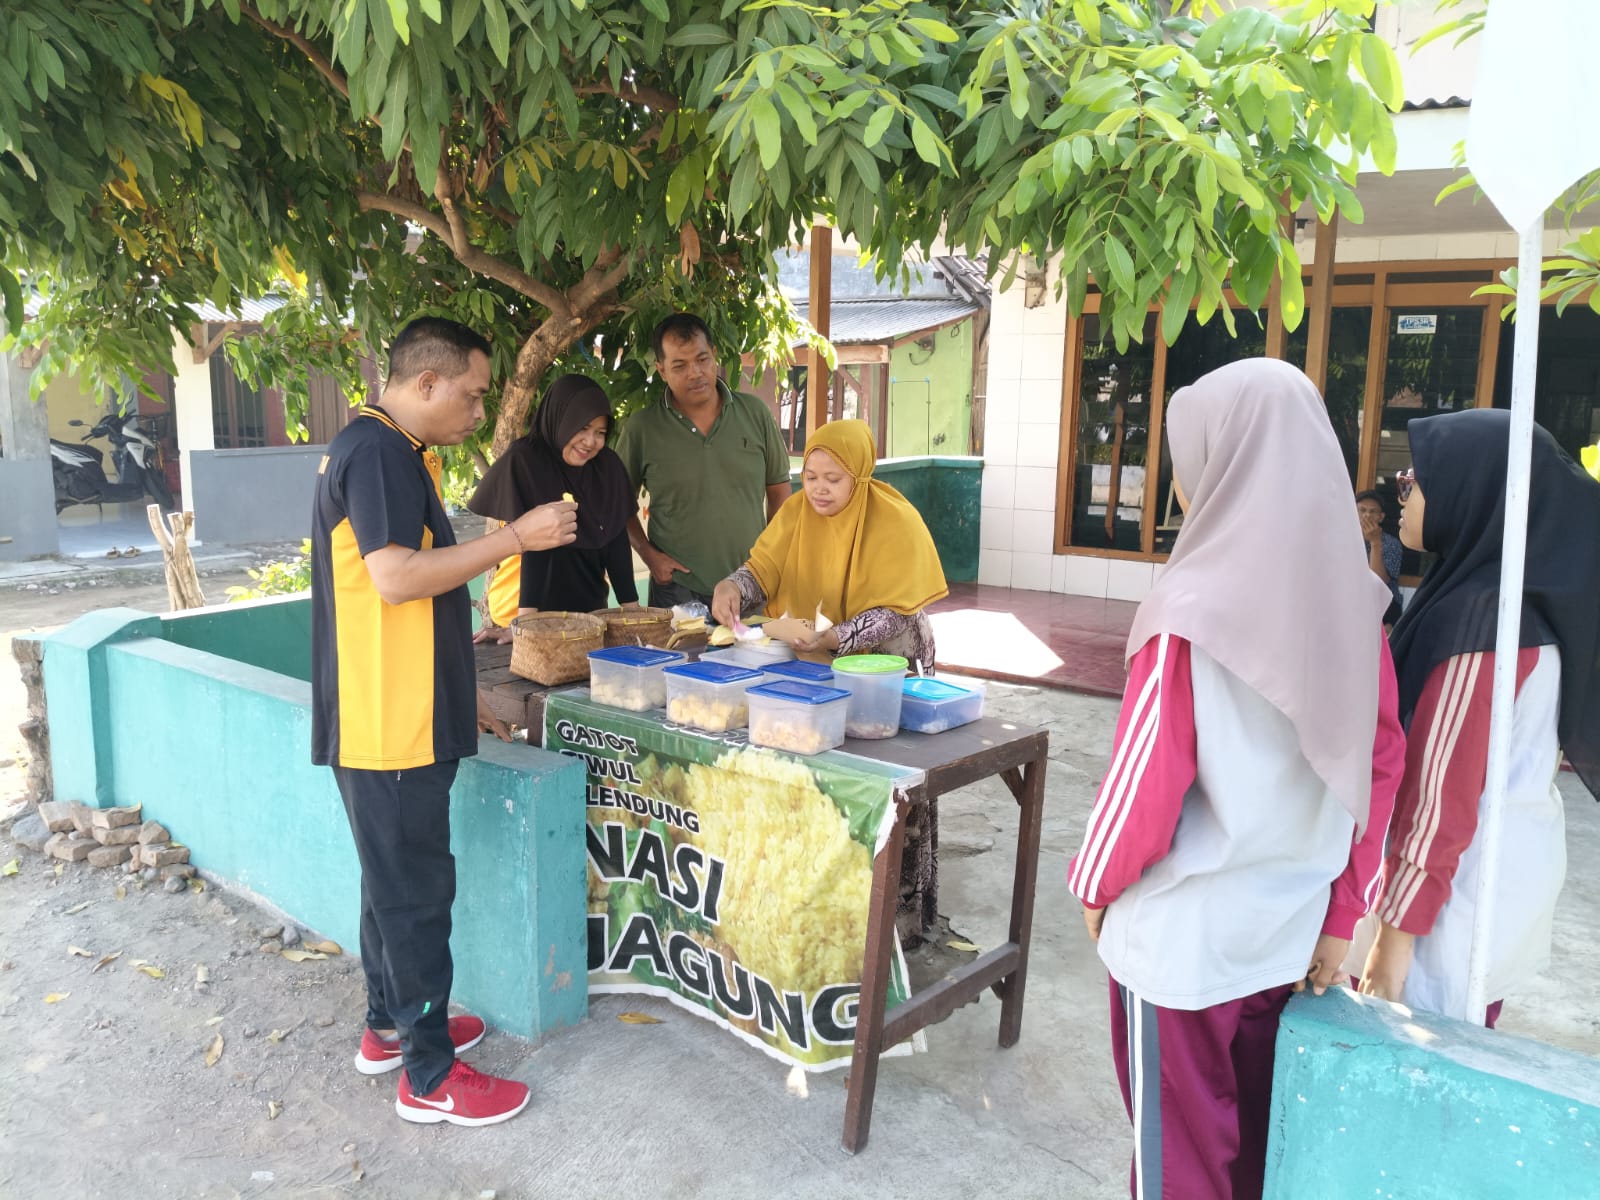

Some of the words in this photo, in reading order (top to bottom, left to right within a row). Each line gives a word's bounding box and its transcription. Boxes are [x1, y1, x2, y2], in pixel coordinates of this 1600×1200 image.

[555, 720, 638, 755] GATOT
[560, 749, 642, 786] WUL
[586, 784, 700, 833] LENDUNG
[586, 821, 725, 926] NASI
